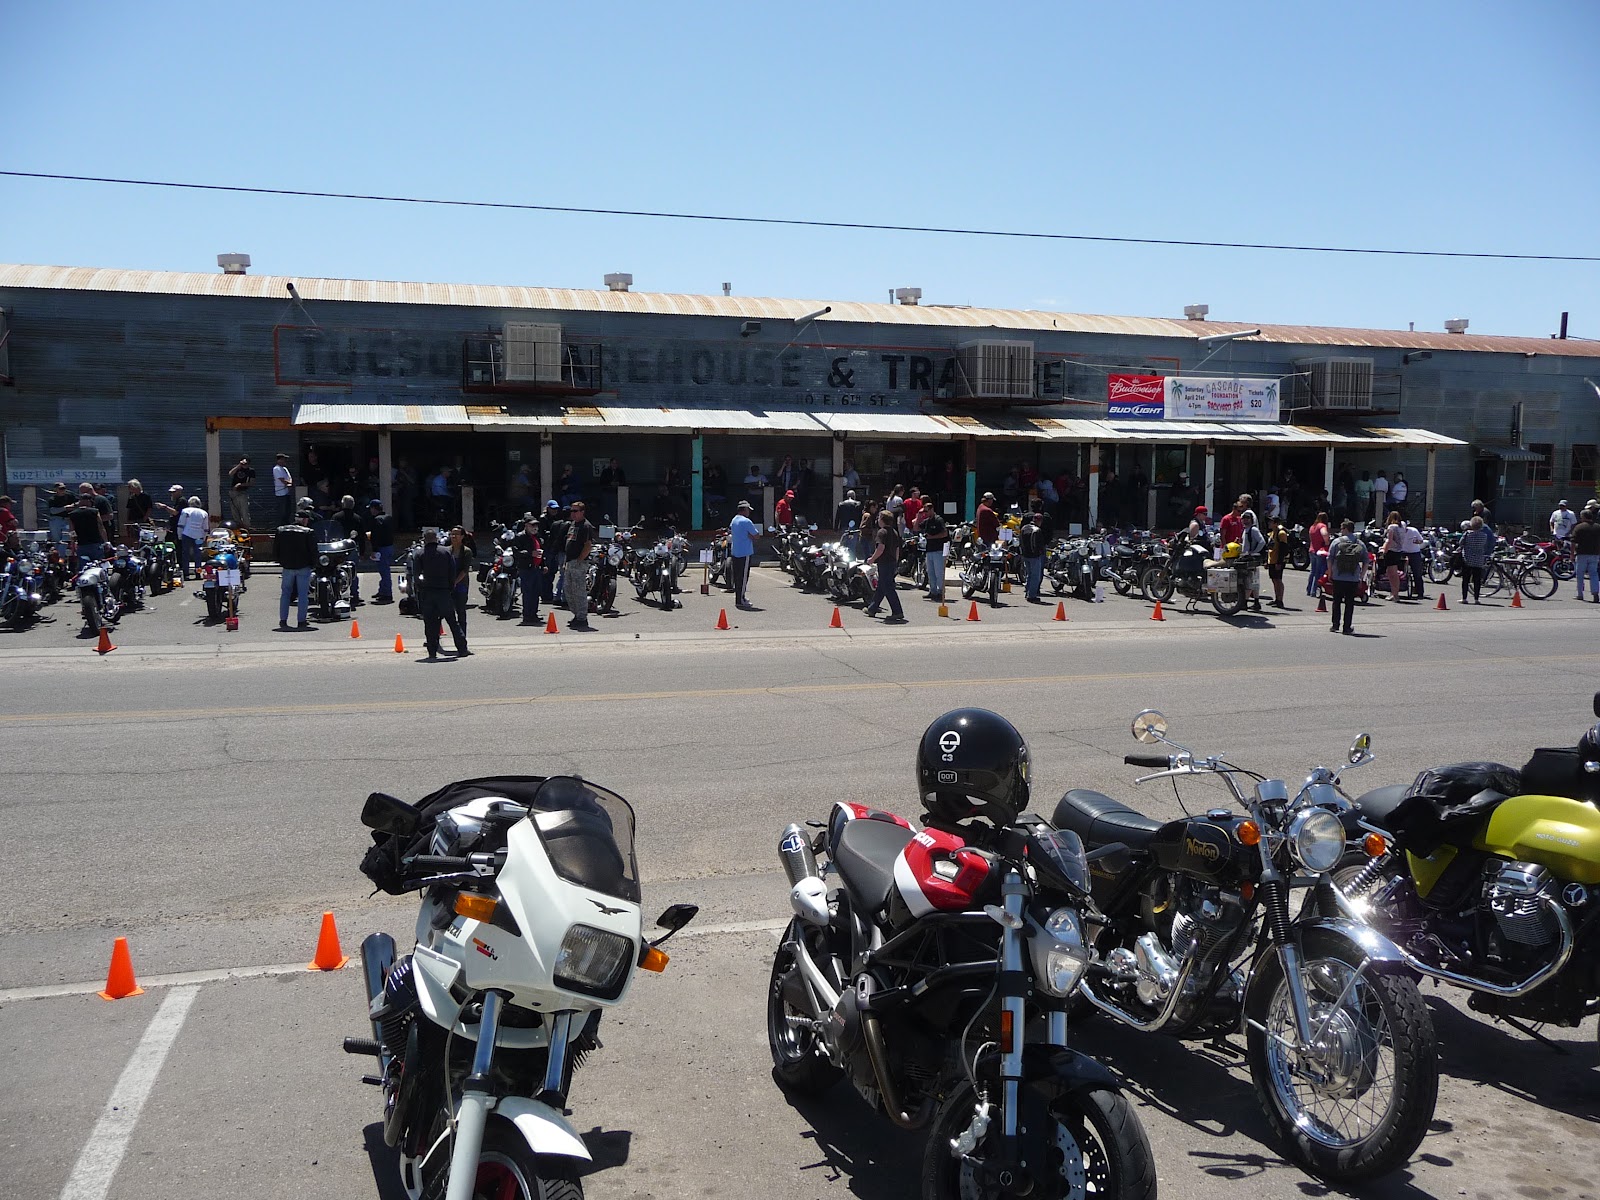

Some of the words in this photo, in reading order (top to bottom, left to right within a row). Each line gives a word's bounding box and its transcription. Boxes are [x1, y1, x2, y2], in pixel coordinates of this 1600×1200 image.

[828, 356, 856, 390] &
[1109, 380, 1163, 394] Budweiser
[1184, 386, 1204, 394] Saturday
[1206, 381, 1244, 394] CASCADE
[1250, 399, 1262, 408] $20
[1109, 406, 1131, 414] BUD
[1134, 407, 1164, 415] LIGHT
[74, 471, 107, 480] 85719
[941, 753, 954, 762] C3
[1536, 832, 1555, 841] MOTO
[1556, 837, 1580, 847] GUZZI
[1185, 838, 1220, 861] Norton
